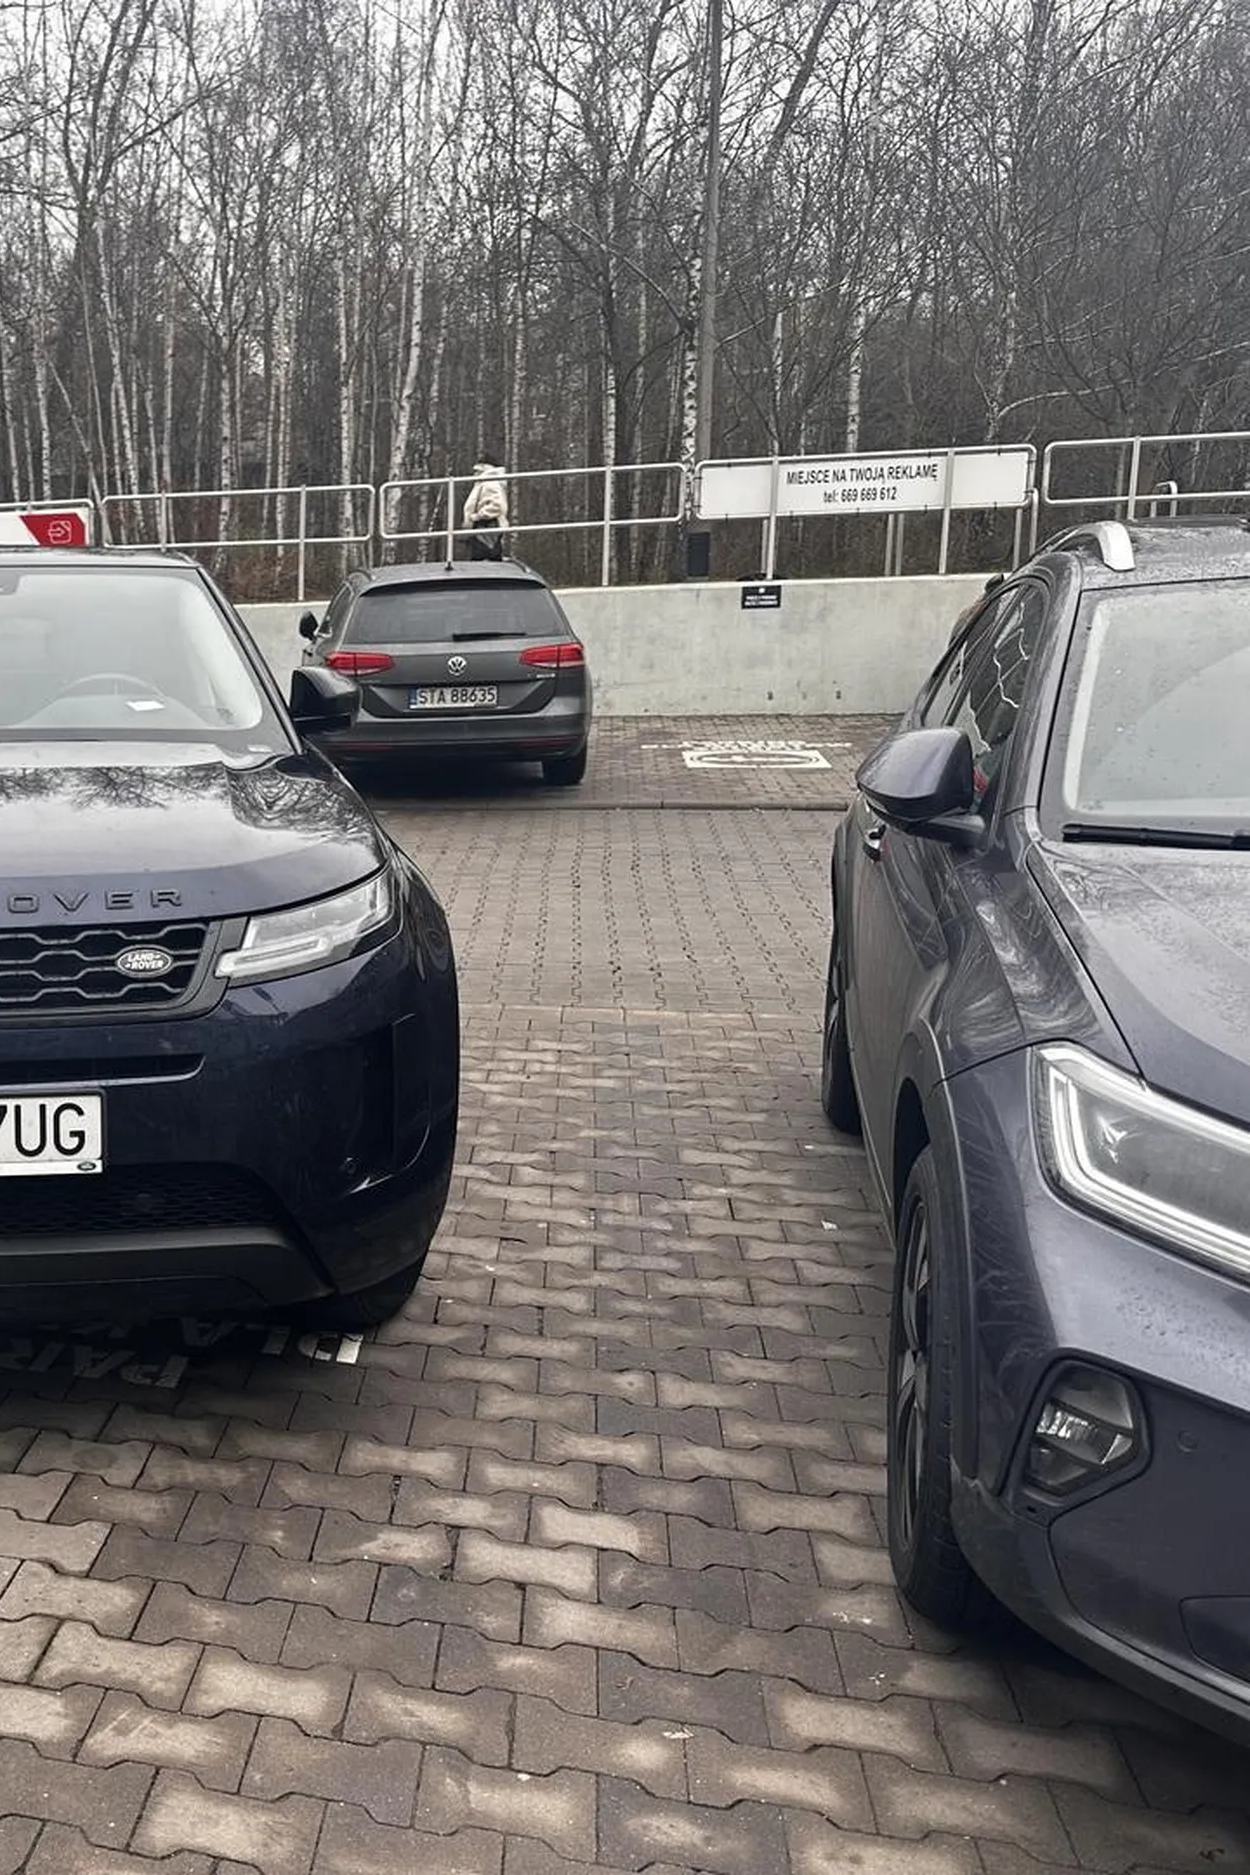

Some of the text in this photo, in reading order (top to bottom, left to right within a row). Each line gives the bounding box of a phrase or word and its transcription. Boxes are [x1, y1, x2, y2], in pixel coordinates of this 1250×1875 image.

[786, 463, 939, 484] MIEJSCE NA TWOJĄ REKLAMĘ
[841, 488, 858, 503] 669
[860, 487, 877, 502] 669
[879, 486, 897, 501] 612
[419, 686, 496, 705] STA 88635
